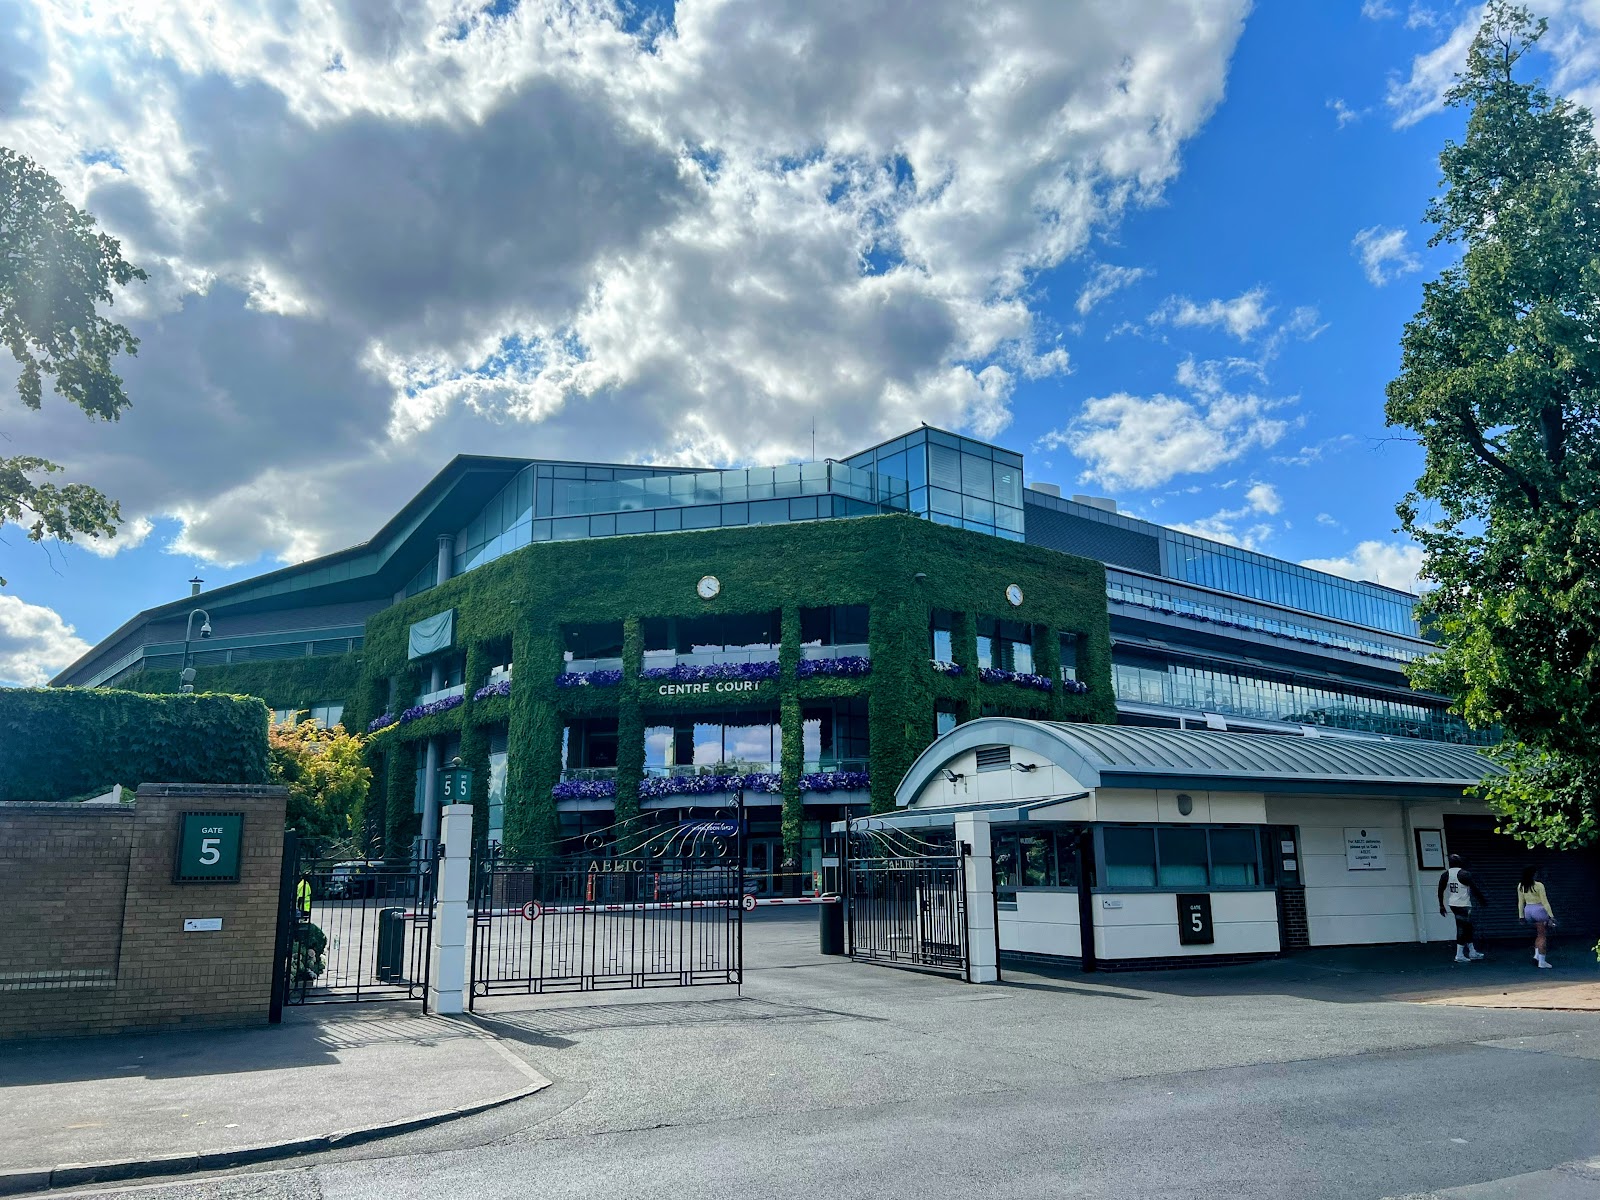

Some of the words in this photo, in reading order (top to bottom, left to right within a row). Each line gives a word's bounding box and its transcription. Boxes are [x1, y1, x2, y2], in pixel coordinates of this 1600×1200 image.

[659, 682, 710, 696] CENTRE
[715, 680, 761, 692] COURT
[444, 780, 451, 796] 5
[460, 780, 467, 796] 5
[199, 838, 221, 865] 5
[588, 859, 644, 873] AELTC
[745, 898, 752, 907] 5
[1191, 912, 1203, 932] 5
